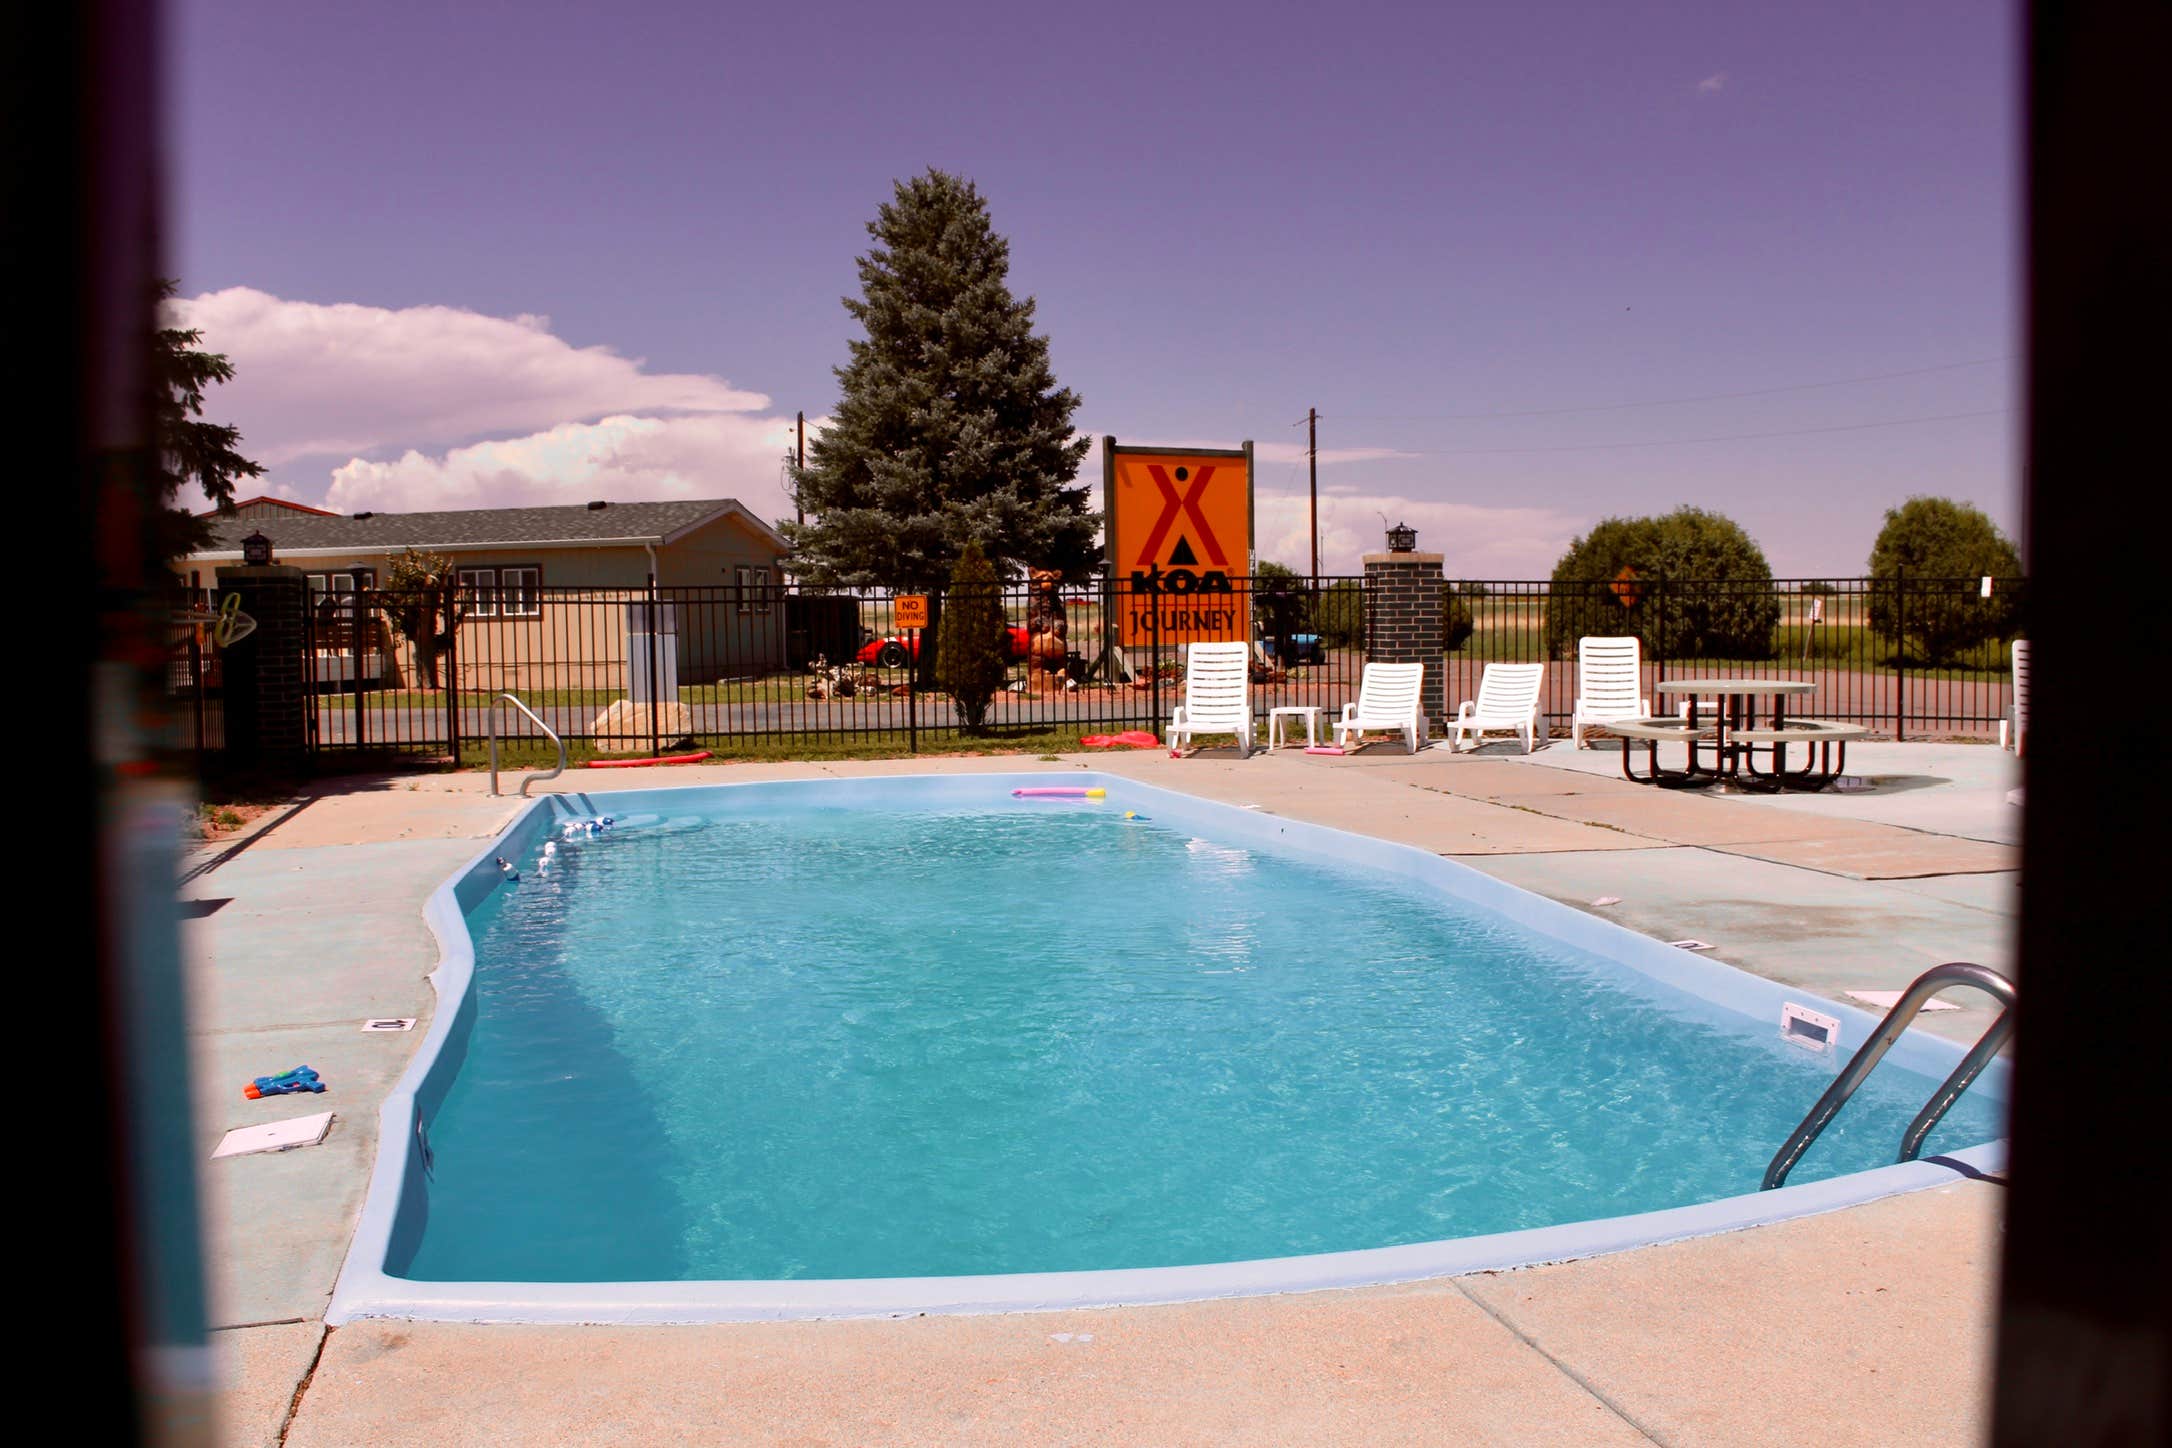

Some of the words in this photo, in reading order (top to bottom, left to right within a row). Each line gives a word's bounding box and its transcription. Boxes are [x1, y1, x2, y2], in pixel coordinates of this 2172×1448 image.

[1131, 569, 1232, 595] KOA
[902, 601, 919, 610] NO
[896, 611, 924, 621] DIVING
[1129, 610, 1236, 636] JOURNEY
